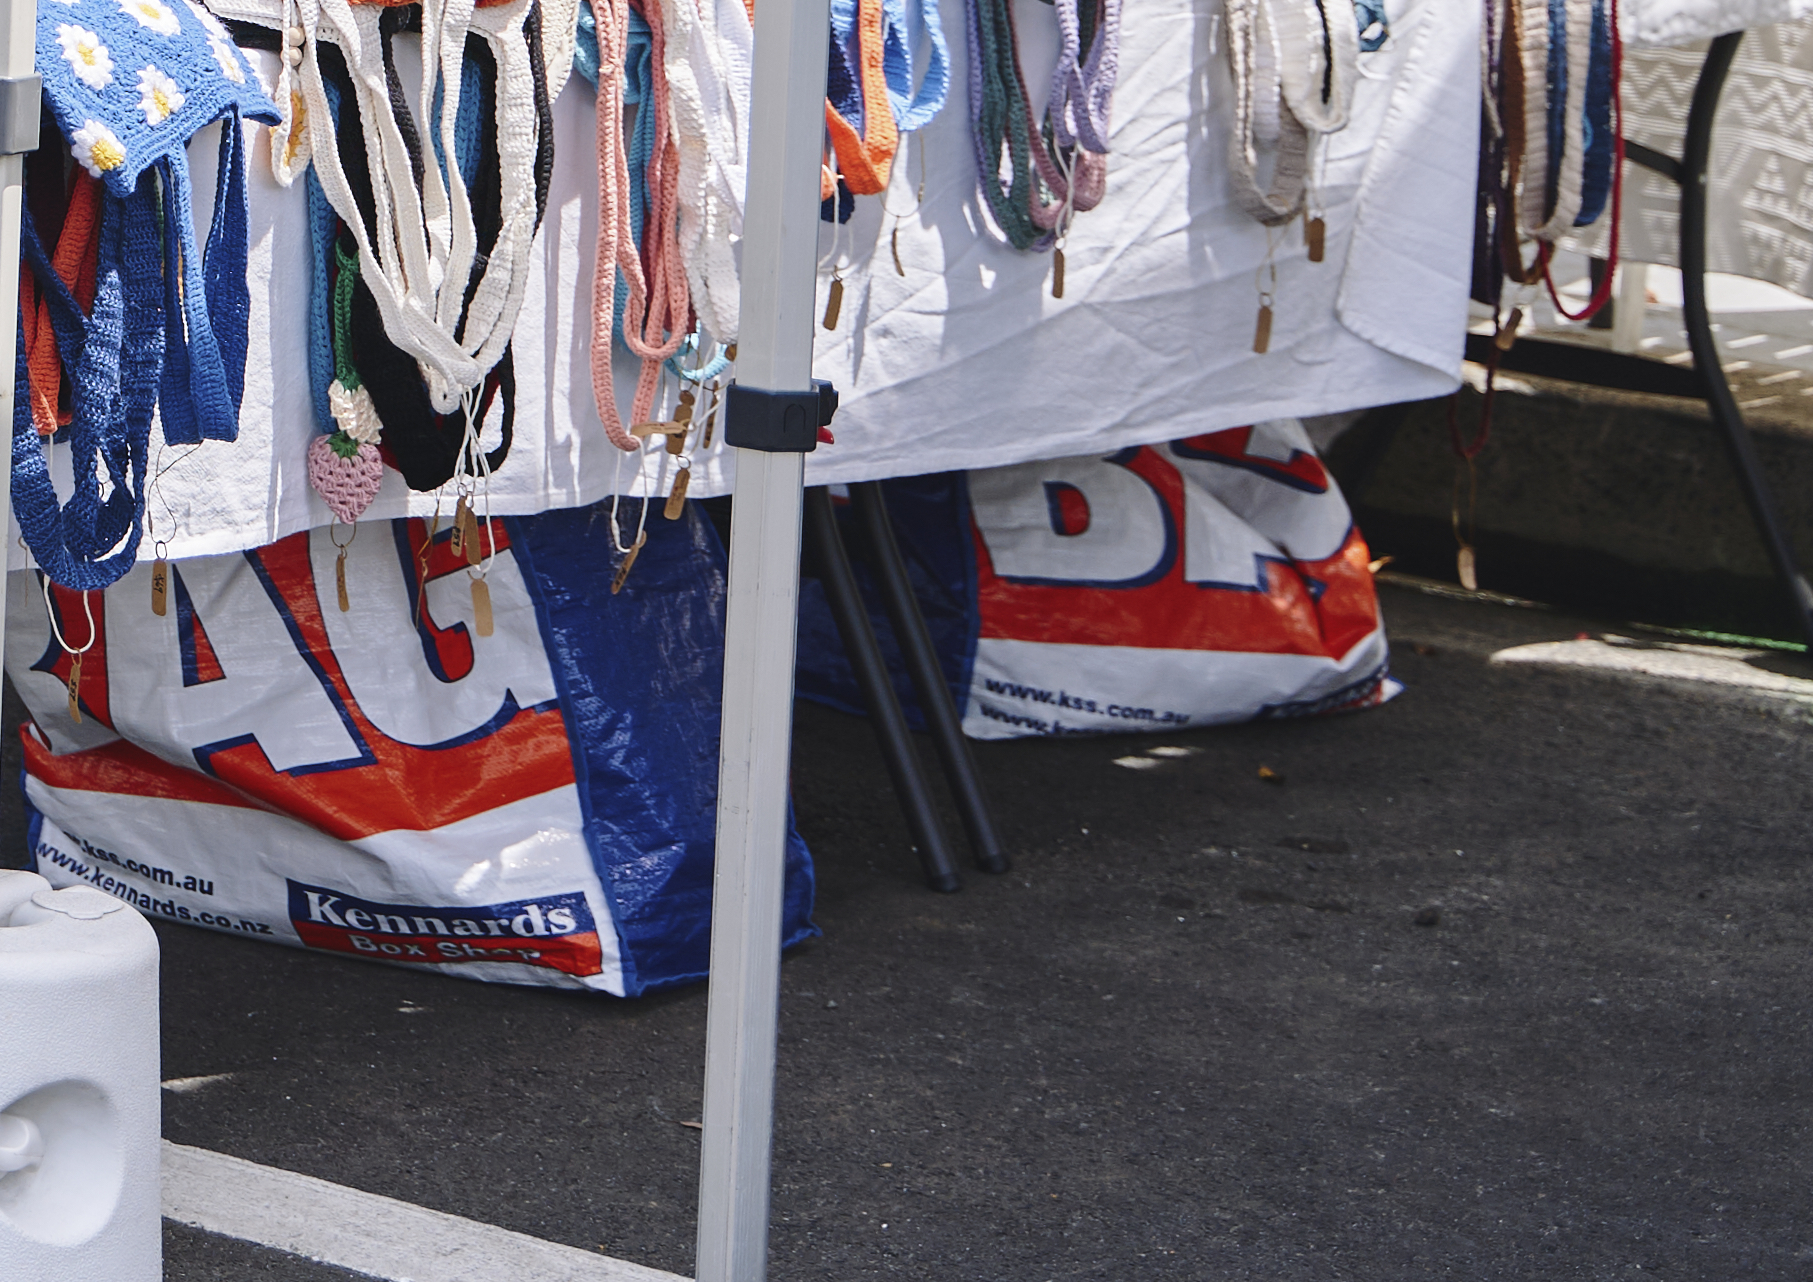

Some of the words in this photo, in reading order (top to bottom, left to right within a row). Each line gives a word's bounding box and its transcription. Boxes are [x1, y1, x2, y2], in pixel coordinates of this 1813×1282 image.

[984, 678, 1192, 724] www.kss.com.au
[37, 841, 274, 935] www.kennards.co.nz
[303, 889, 578, 938] Kennards
[348, 934, 427, 957] Box
